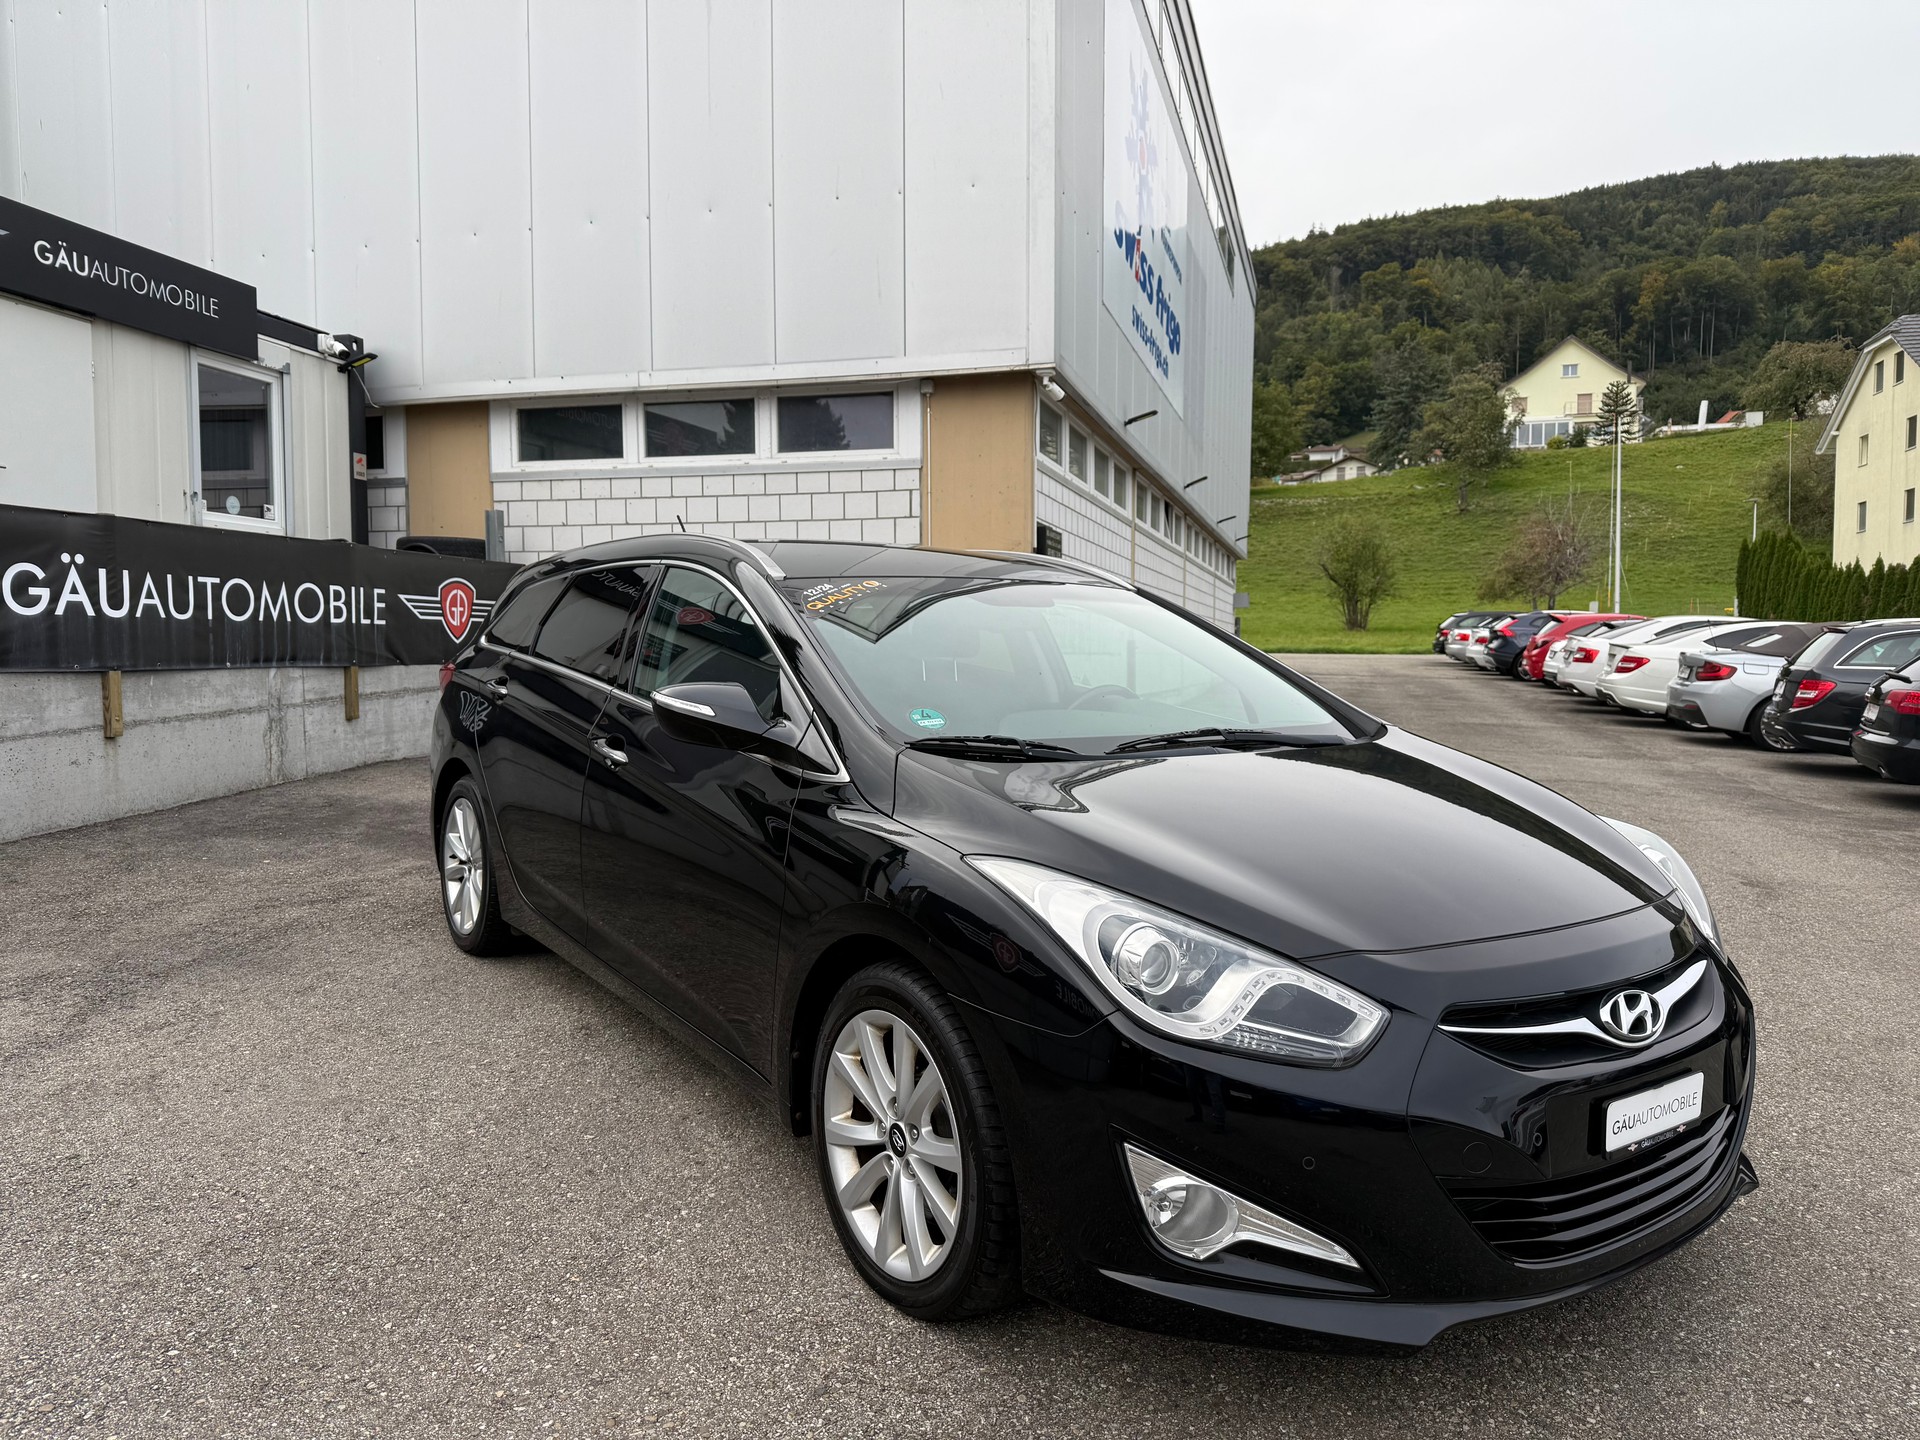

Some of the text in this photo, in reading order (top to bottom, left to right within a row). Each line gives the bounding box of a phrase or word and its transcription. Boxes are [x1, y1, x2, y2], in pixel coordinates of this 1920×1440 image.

[33, 239, 220, 319] GÄUAUTOMOBILE
[1156, 274, 1181, 355] frigo
[2, 553, 387, 625] GÄUAUTOMOBILE
[803, 583, 834, 597] 12/24
[1612, 1091, 1698, 1136] GÄUAUTOMOBILE
